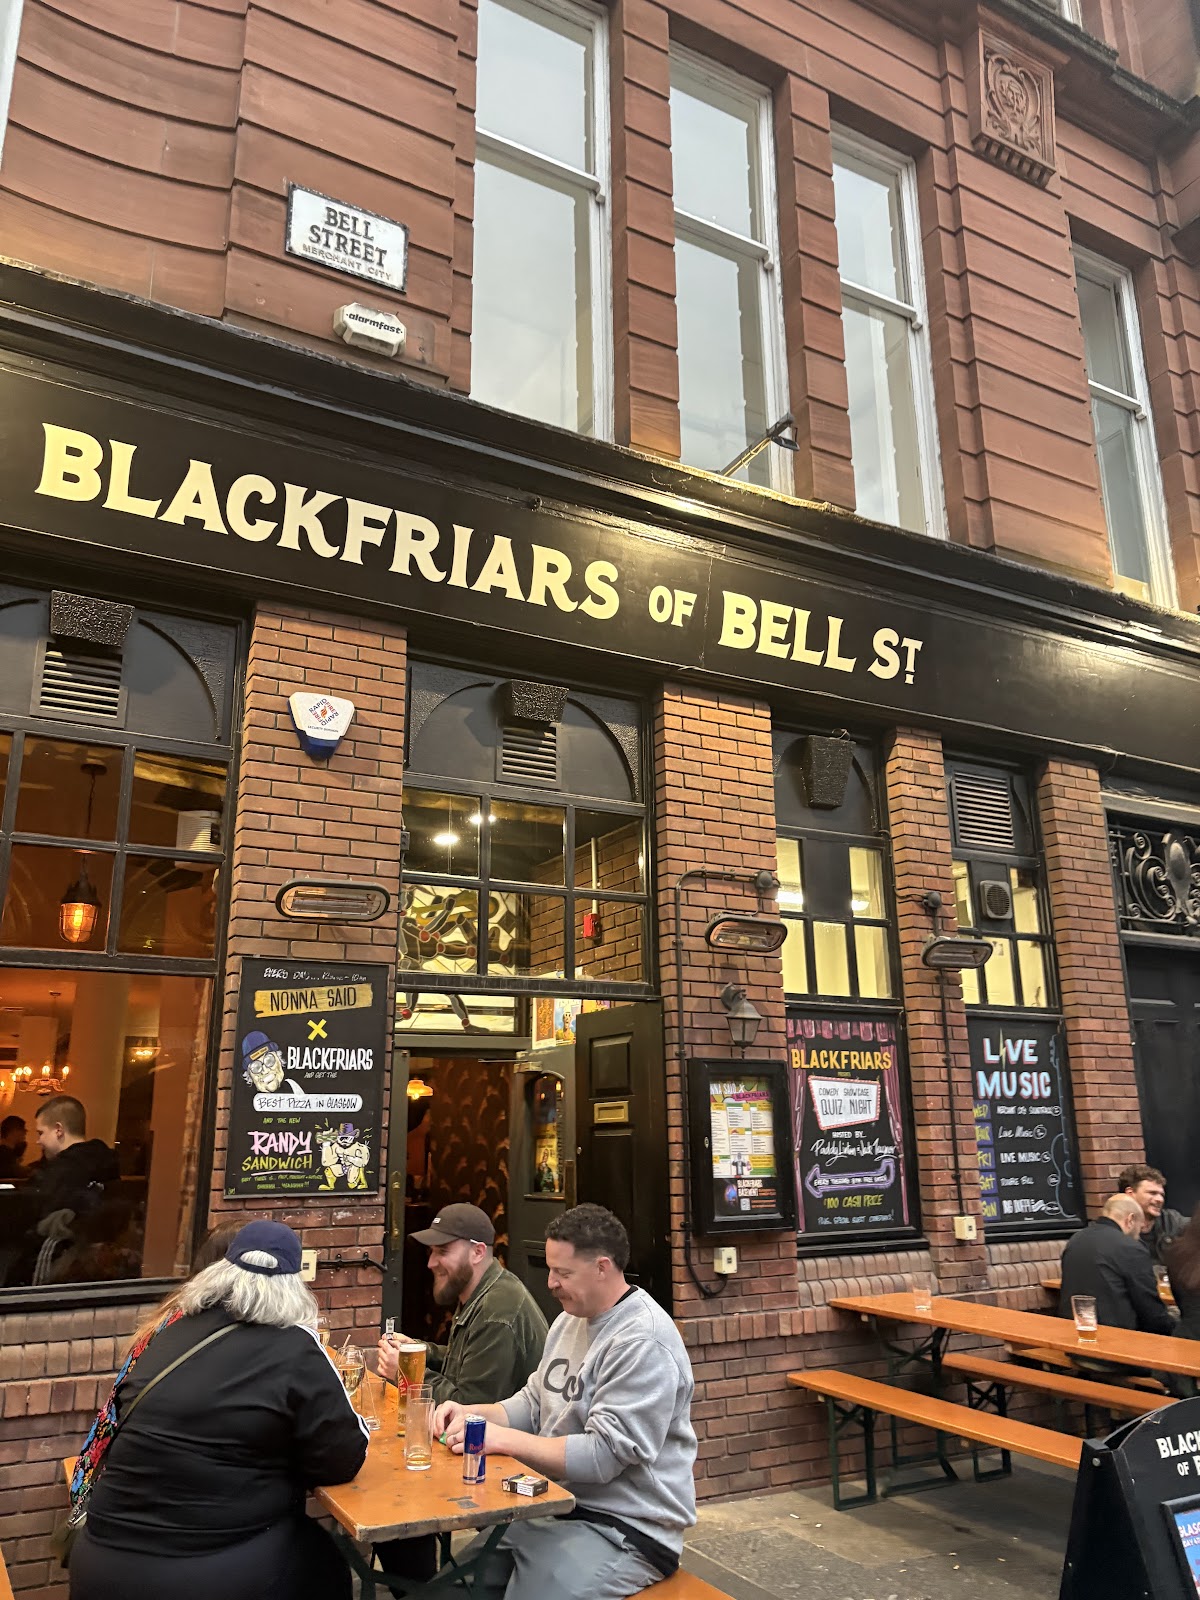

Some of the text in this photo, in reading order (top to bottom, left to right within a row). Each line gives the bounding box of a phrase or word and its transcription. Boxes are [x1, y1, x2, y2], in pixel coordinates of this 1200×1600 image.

[325, 206, 374, 241] BELL
[308, 224, 387, 268] STREET
[302, 243, 392, 281] MERCHANT CITY
[347, 313, 403, 334] alarmfast
[35, 422, 621, 619] BLACKFRIARS
[648, 585, 698, 627] OF
[717, 590, 857, 672] BELL
[309, 698, 327, 713] RAPID
[321, 711, 339, 726] RAPID
[270, 986, 357, 1011] NONNA SAID
[287, 1046, 374, 1070] BLACKFRIARS
[791, 1048, 892, 1070] BLACKFRIARS
[982, 1033, 1039, 1068] LIVE
[818, 1087, 870, 1097] COMEDY SHOWCASE
[976, 1070, 1052, 1099] MUSIC
[256, 1096, 284, 1109] BEST
[287, 1097, 312, 1109] PIZZA
[326, 1096, 358, 1109] GLASGOW
[820, 1098, 872, 1116] QUIZ NIGHT
[247, 1130, 312, 1156] RANDY
[832, 1131, 852, 1139] HOSTED
[241, 1154, 312, 1171] SANDWICH
[977, 1150, 992, 1167] FRI
[1000, 1151, 1017, 1164] LIVE
[1018, 1151, 1042, 1163] MUSIC
[843, 1195, 862, 1208] CASH
[863, 1194, 884, 1207] PRIZE
[1176, 1461, 1190, 1477] OF
